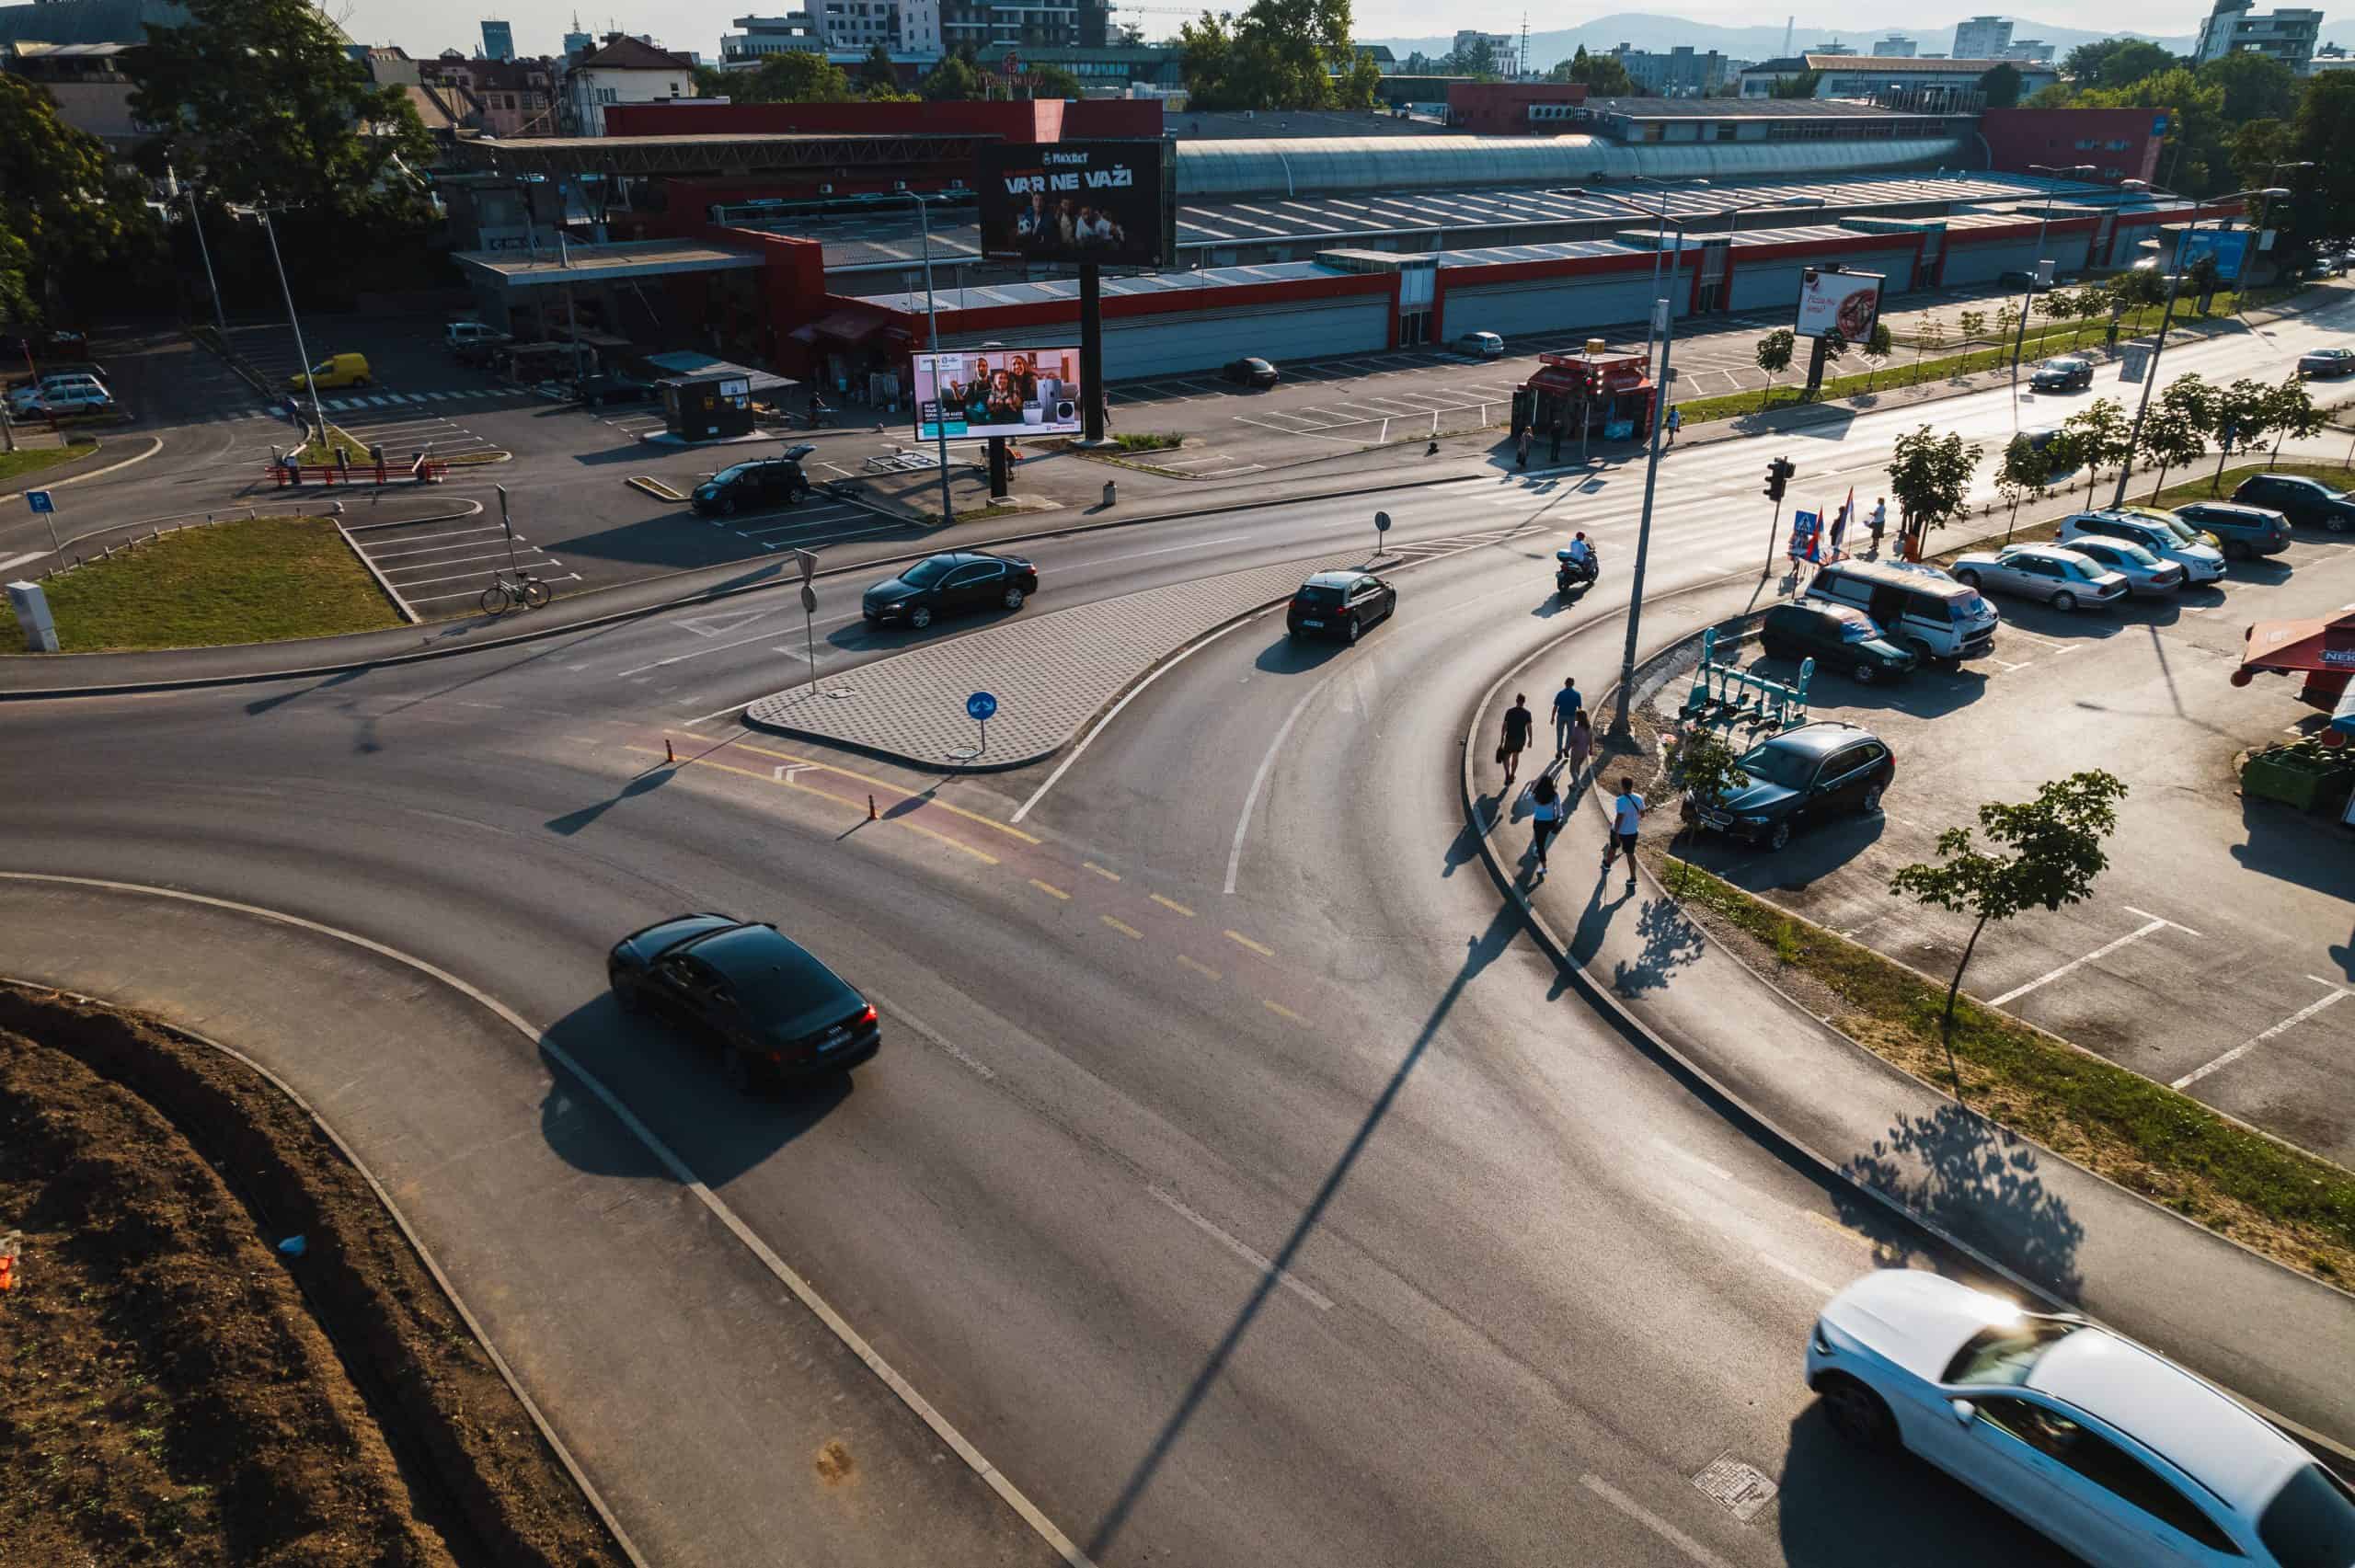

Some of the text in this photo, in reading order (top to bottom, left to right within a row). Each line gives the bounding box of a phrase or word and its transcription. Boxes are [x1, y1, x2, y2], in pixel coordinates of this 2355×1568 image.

[1005, 164, 1132, 194] VAR NE VAŽI
[34, 496, 45, 508] P
